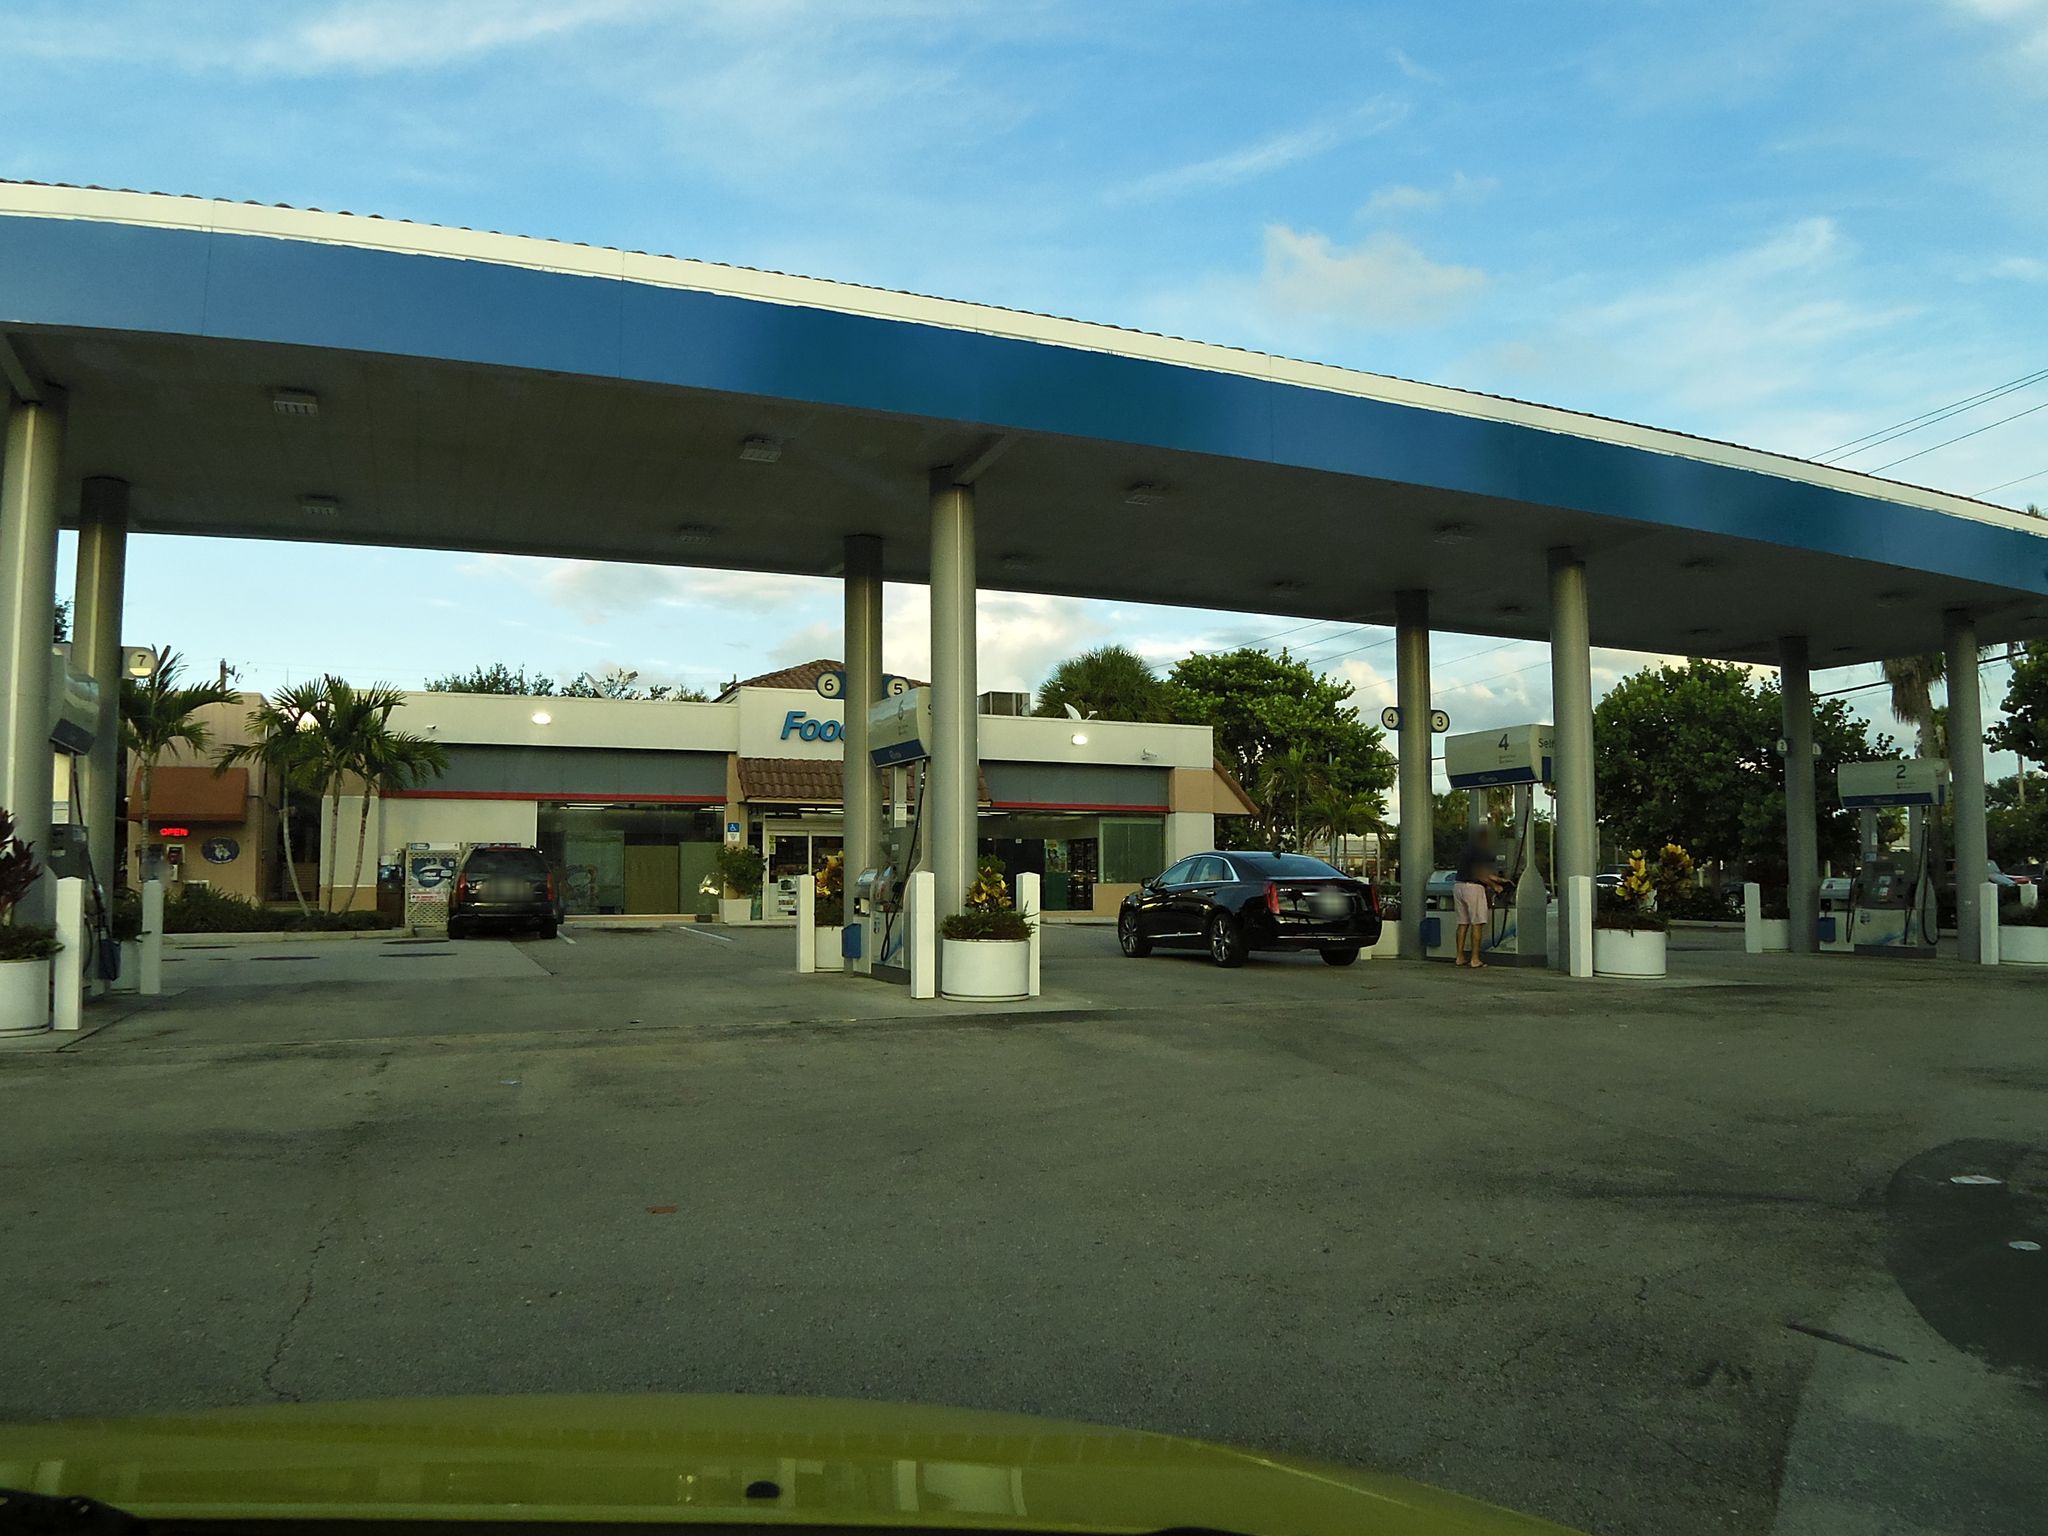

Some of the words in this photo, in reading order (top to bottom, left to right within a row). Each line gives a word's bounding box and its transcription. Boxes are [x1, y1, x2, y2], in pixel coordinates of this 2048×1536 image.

[137, 654, 147, 666] 7
[824, 679, 834, 691] 6
[893, 683, 903, 696] 5
[1387, 713, 1395, 724] 4
[1436, 716, 1444, 727] 3
[780, 710, 845, 742] Foo
[1498, 733, 1509, 751] 4
[1896, 764, 1906, 779] 2
[160, 828, 188, 836] OPEN
